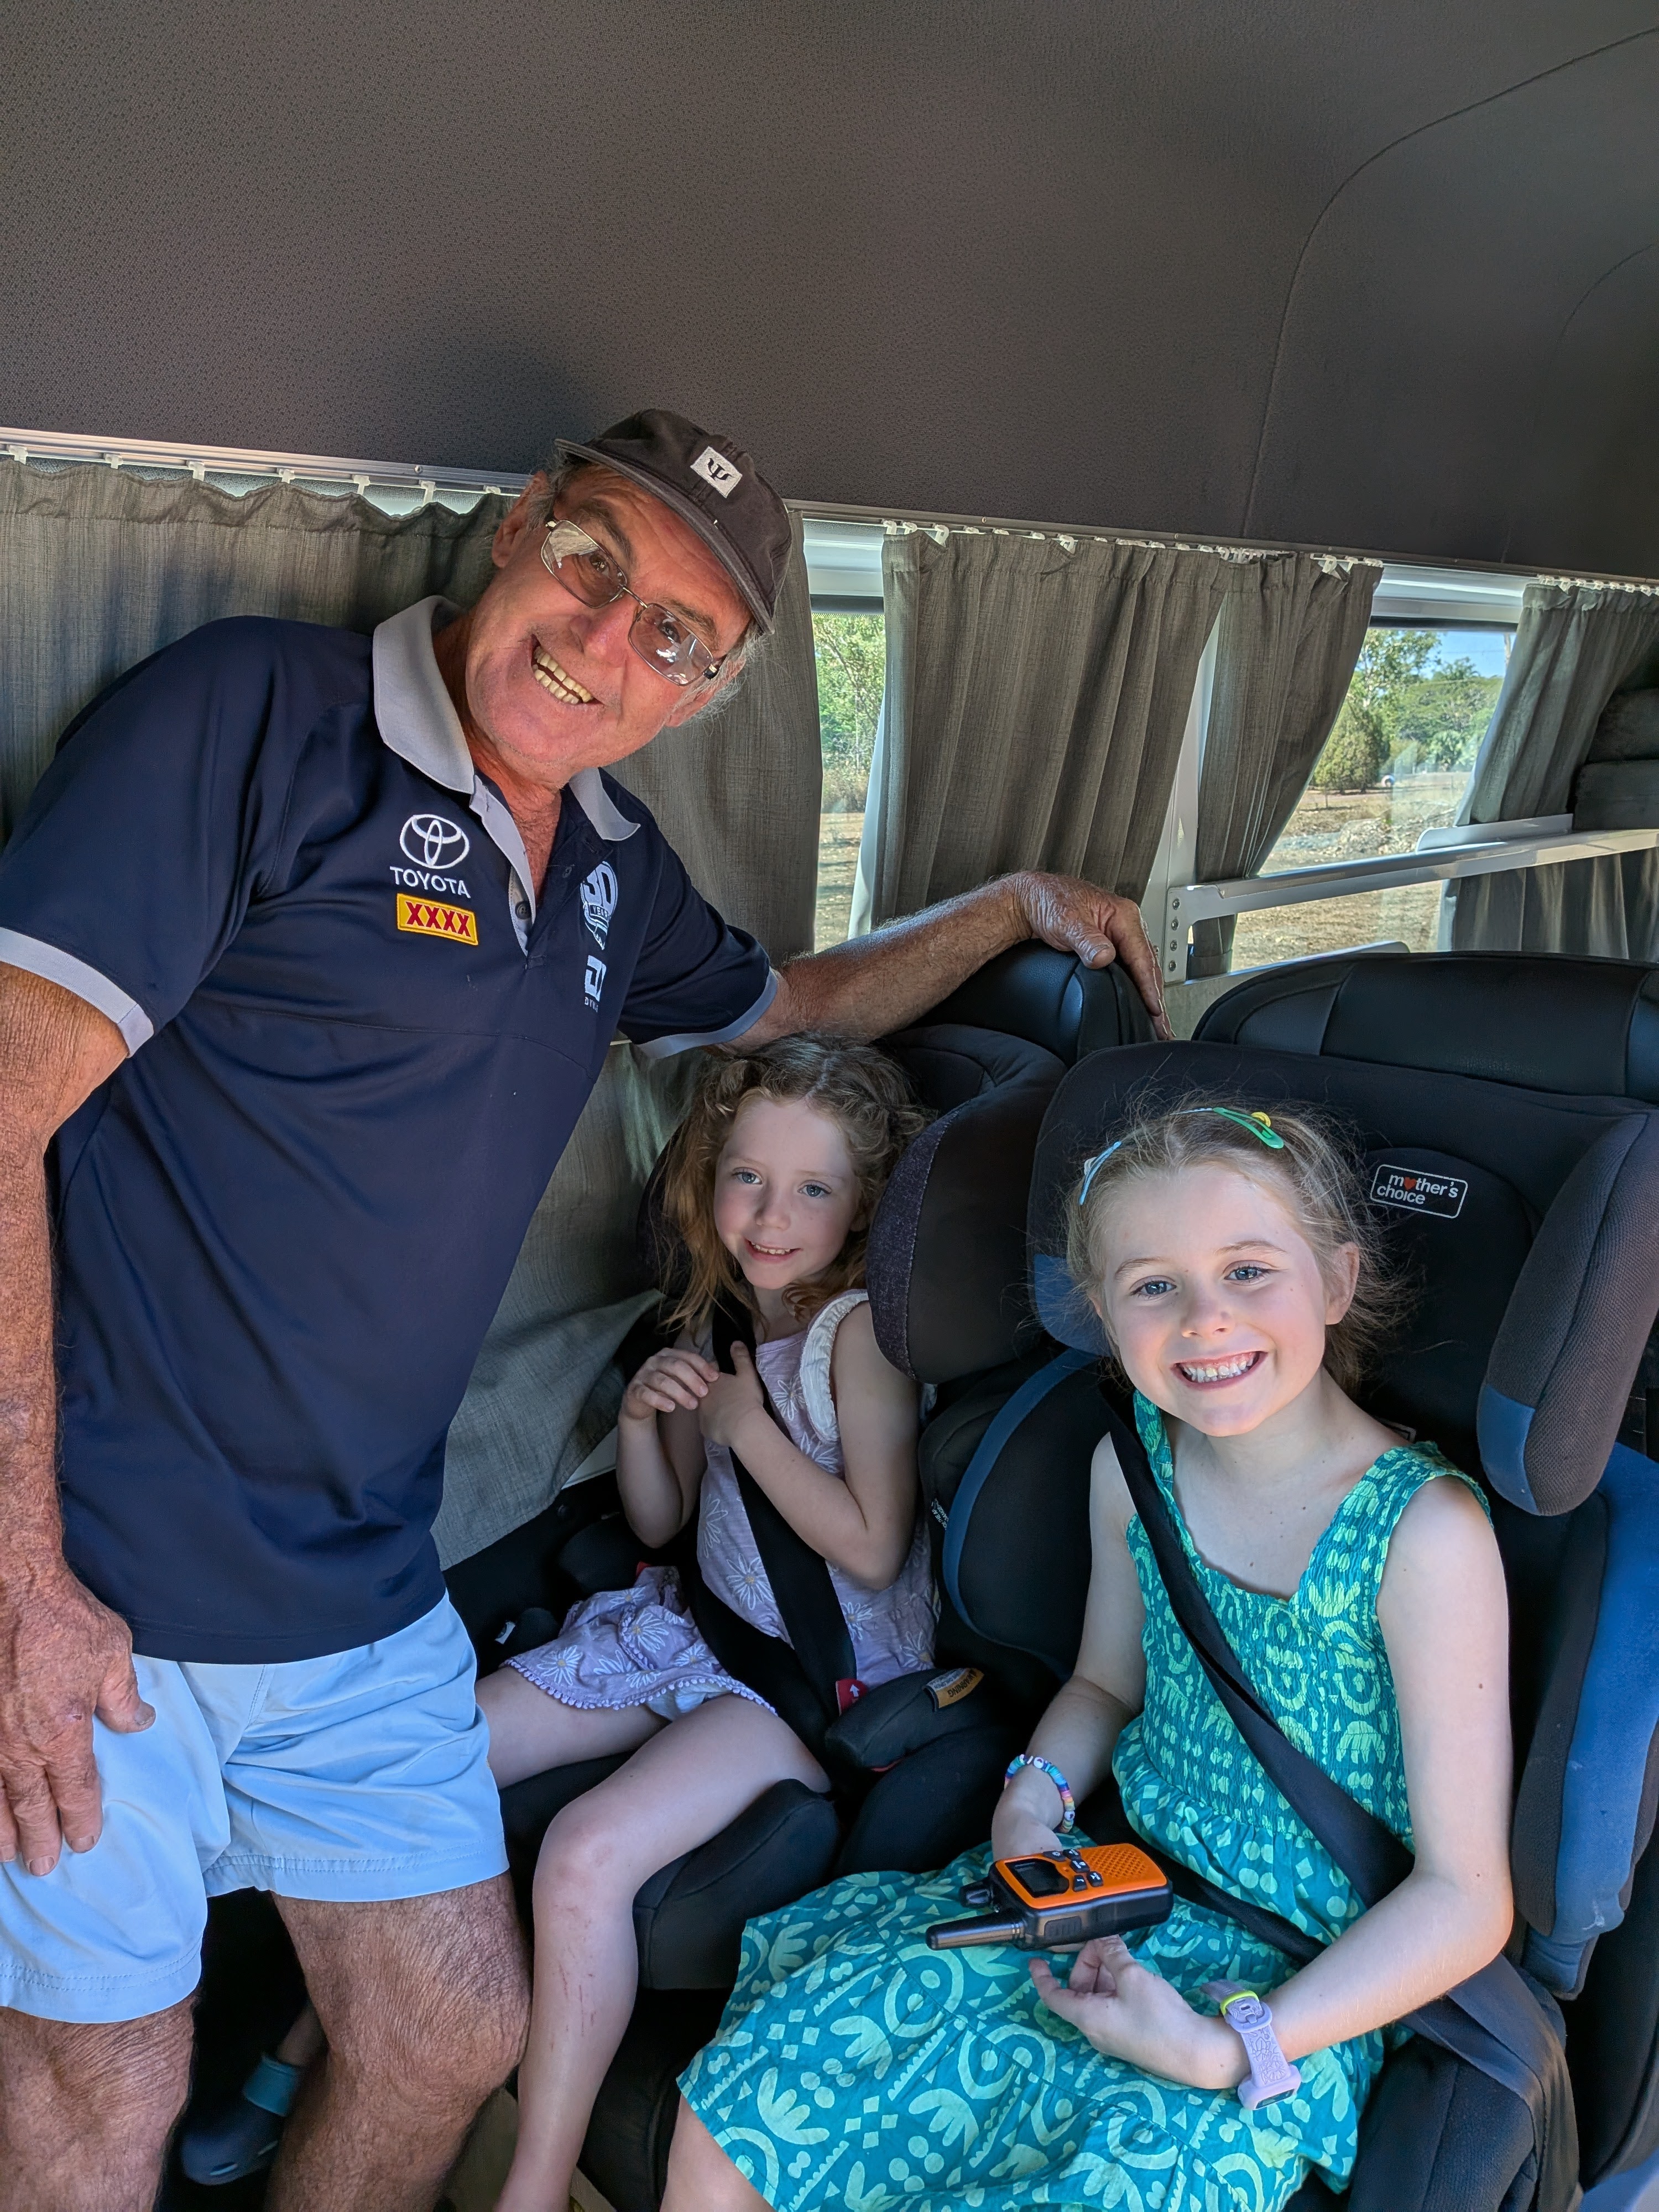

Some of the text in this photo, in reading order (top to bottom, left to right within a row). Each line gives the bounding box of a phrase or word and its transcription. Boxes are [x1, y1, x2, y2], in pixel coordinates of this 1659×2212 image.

[389, 865, 471, 899] TOYOTA
[405, 900, 472, 938] XXXX
[1376, 1183, 1426, 1205] choice
